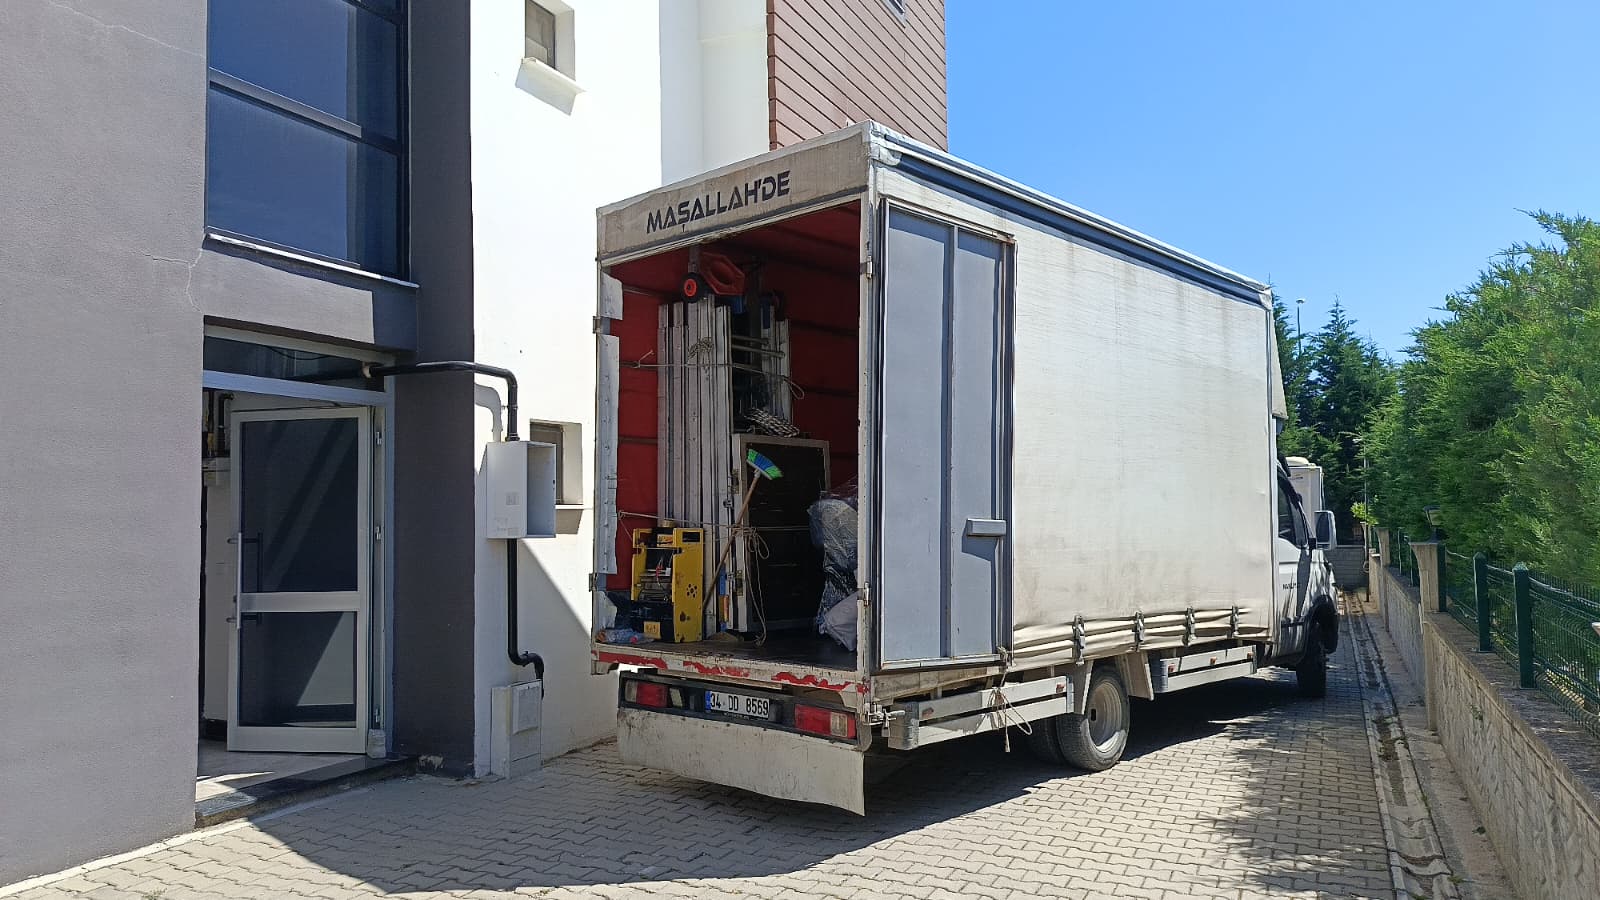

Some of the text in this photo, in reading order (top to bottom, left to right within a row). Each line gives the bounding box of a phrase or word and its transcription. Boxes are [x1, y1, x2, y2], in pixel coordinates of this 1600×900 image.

[646, 170, 791, 234] MAŞALLAH'DE
[710, 692, 722, 709] 34
[728, 695, 739, 711] DD
[746, 698, 769, 716] 8569
